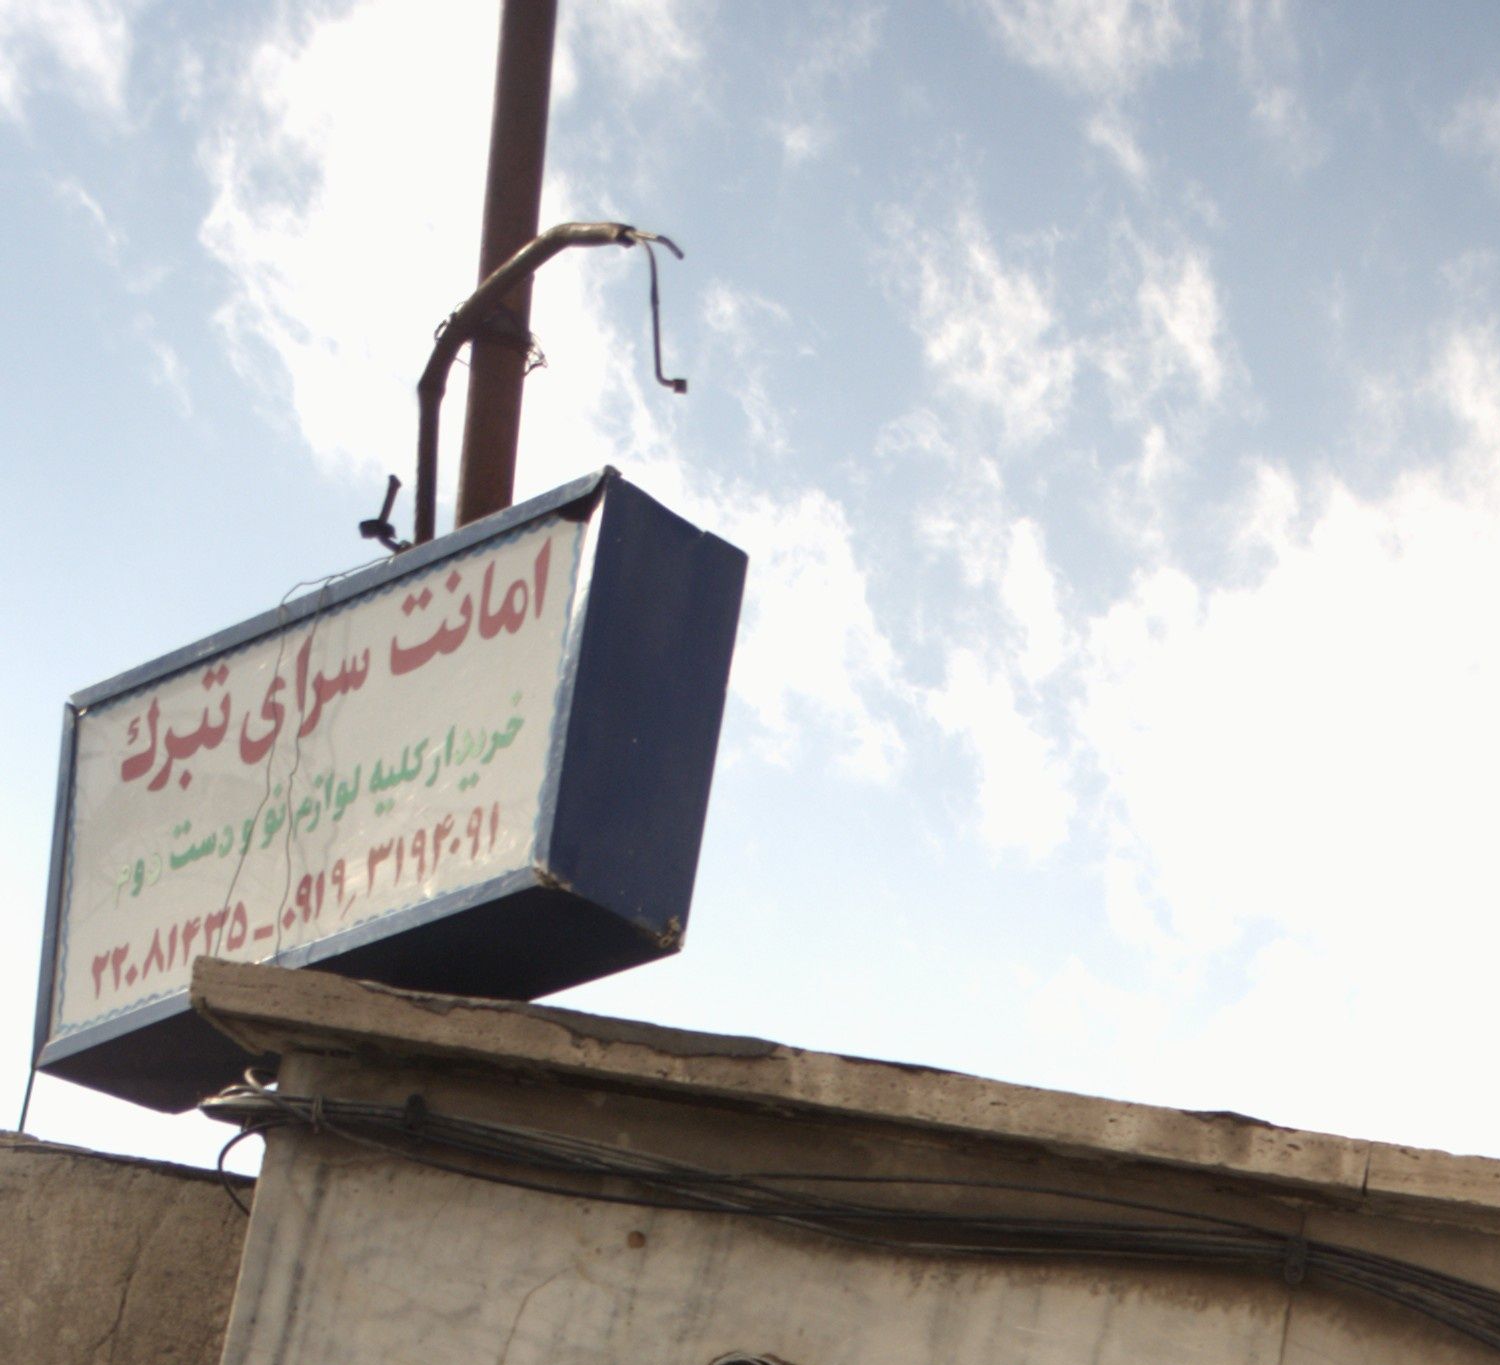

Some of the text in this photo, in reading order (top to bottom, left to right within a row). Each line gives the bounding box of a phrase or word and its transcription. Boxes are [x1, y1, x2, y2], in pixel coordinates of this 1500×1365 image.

[389, 538, 550, 676] امانت
[240, 636, 370, 764] سرای
[169, 819, 233, 869] دست
